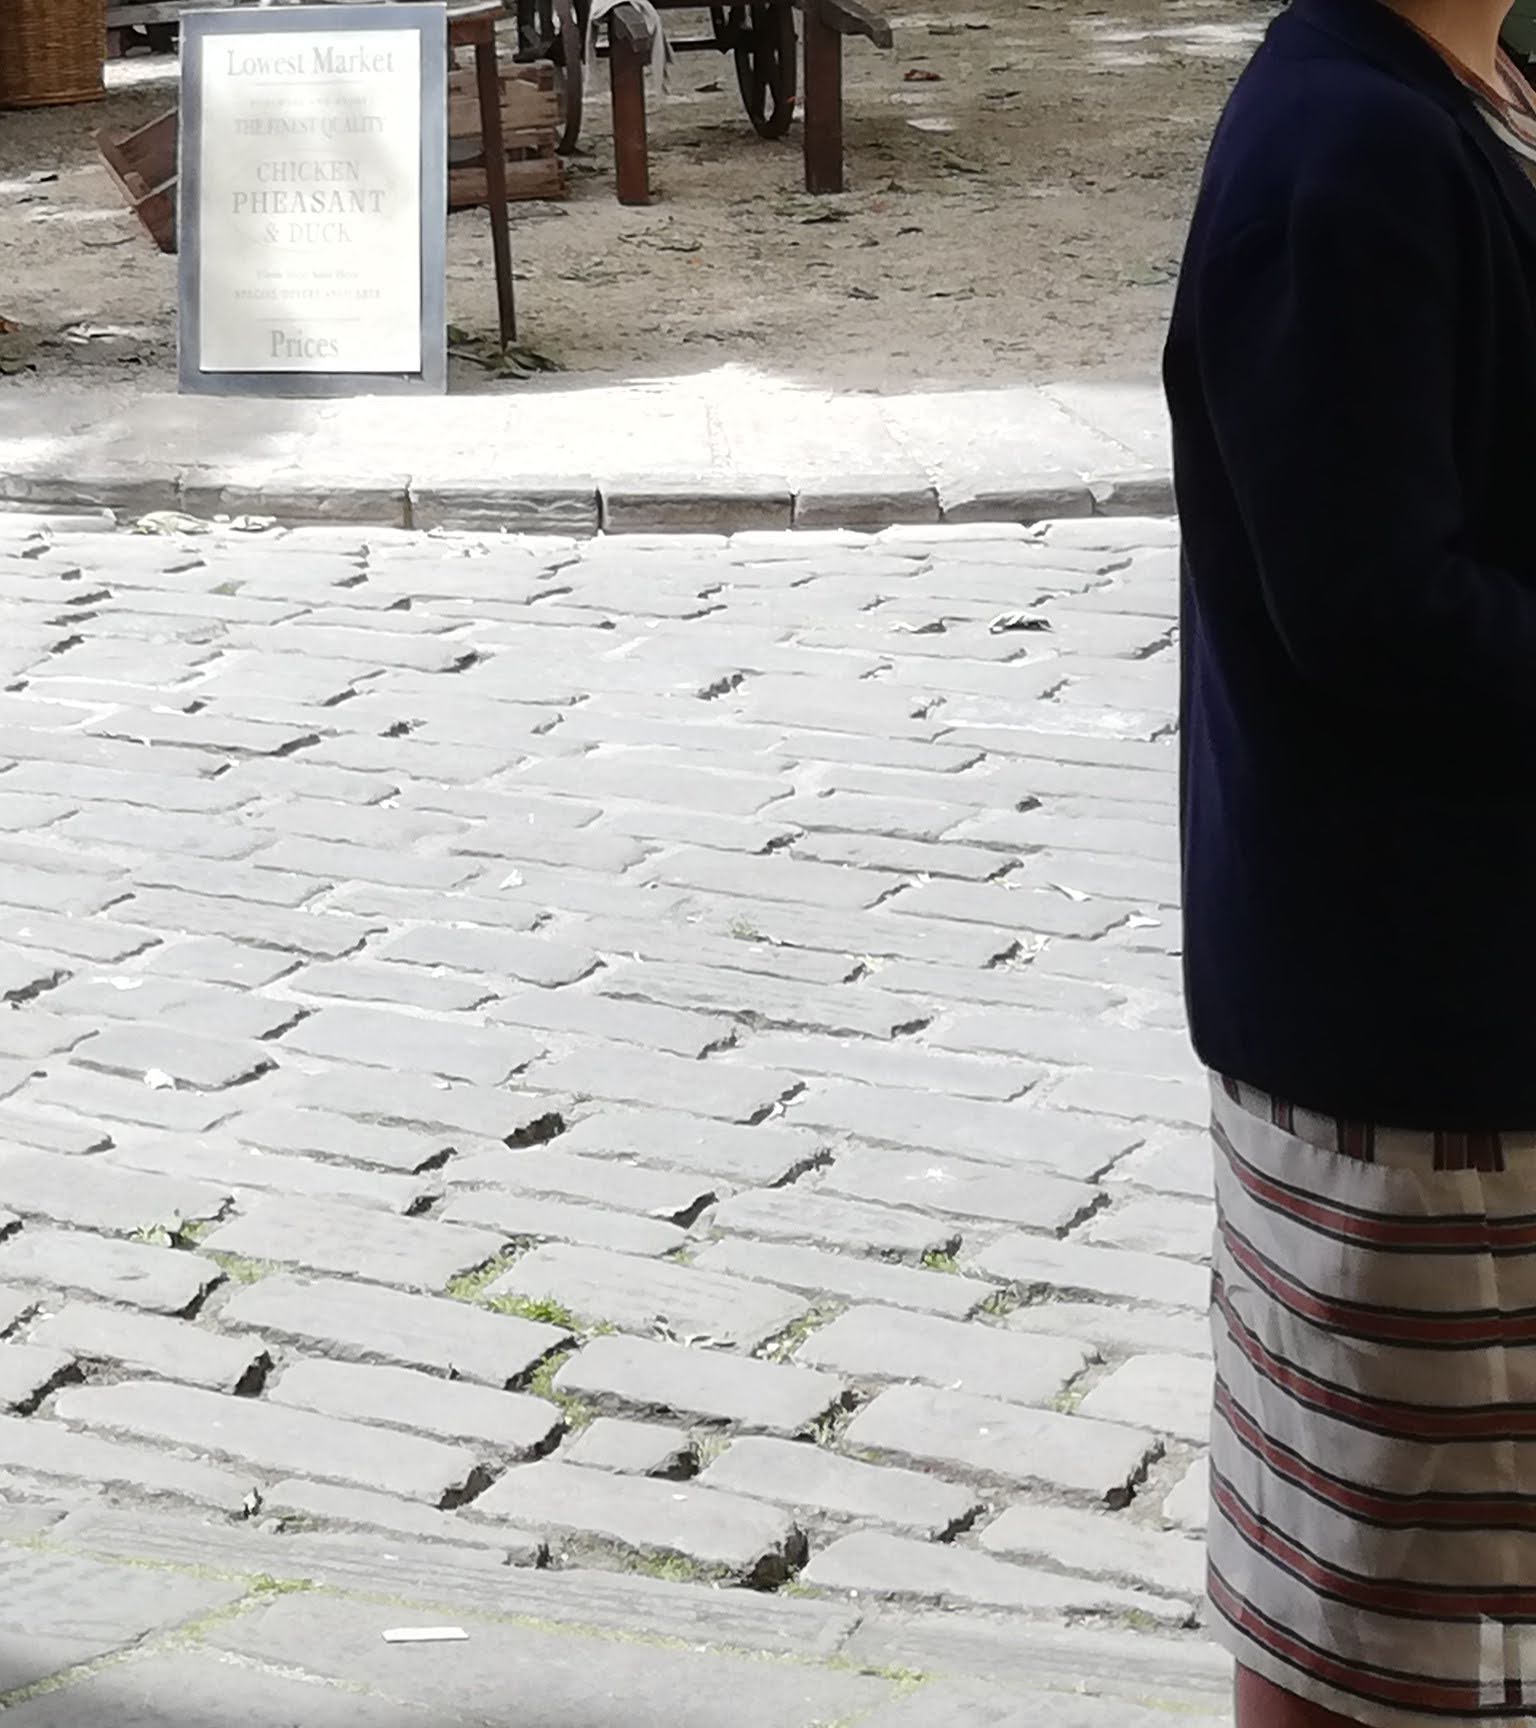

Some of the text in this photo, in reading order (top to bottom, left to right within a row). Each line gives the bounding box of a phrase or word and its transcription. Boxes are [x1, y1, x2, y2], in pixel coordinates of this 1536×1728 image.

[228, 45, 395, 76] Lowest Market
[256, 161, 360, 183] CHICKEN
[232, 190, 385, 214] PHEASANT
[263, 222, 352, 243] & DUCK
[270, 330, 339, 359] Prices
